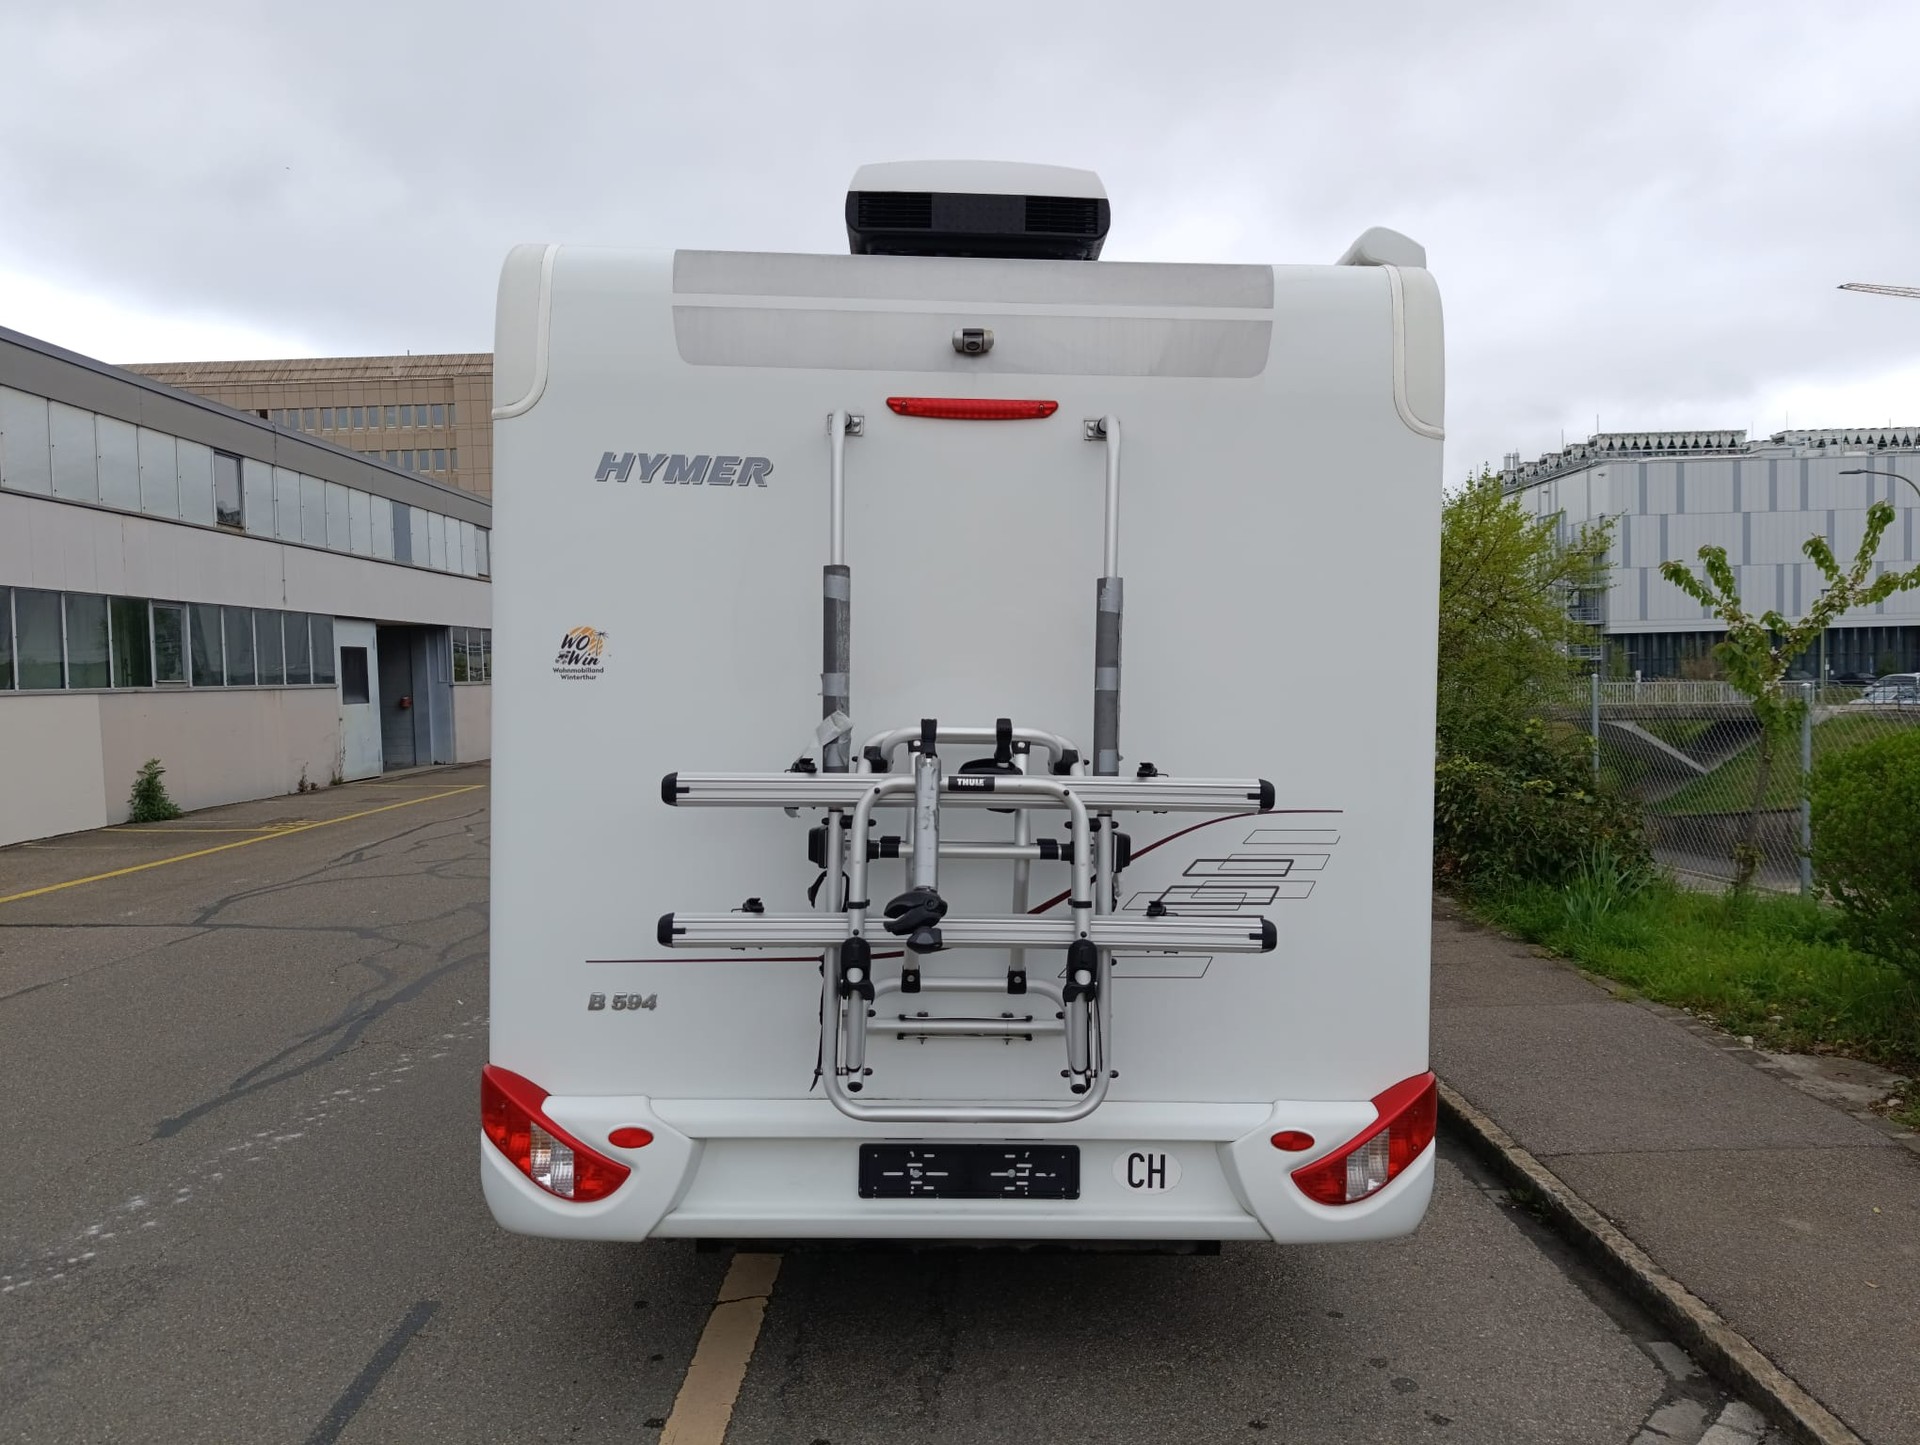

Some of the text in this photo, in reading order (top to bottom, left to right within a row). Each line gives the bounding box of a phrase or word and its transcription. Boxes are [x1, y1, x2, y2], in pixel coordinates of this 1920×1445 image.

[594, 451, 774, 488] HYMER
[561, 633, 591, 651] WO
[567, 650, 600, 666] Win
[552, 666, 605, 674] Wohnmobilland
[956, 777, 986, 787] THULE
[587, 991, 658, 1011] B 594
[1127, 1152, 1166, 1189] CH
